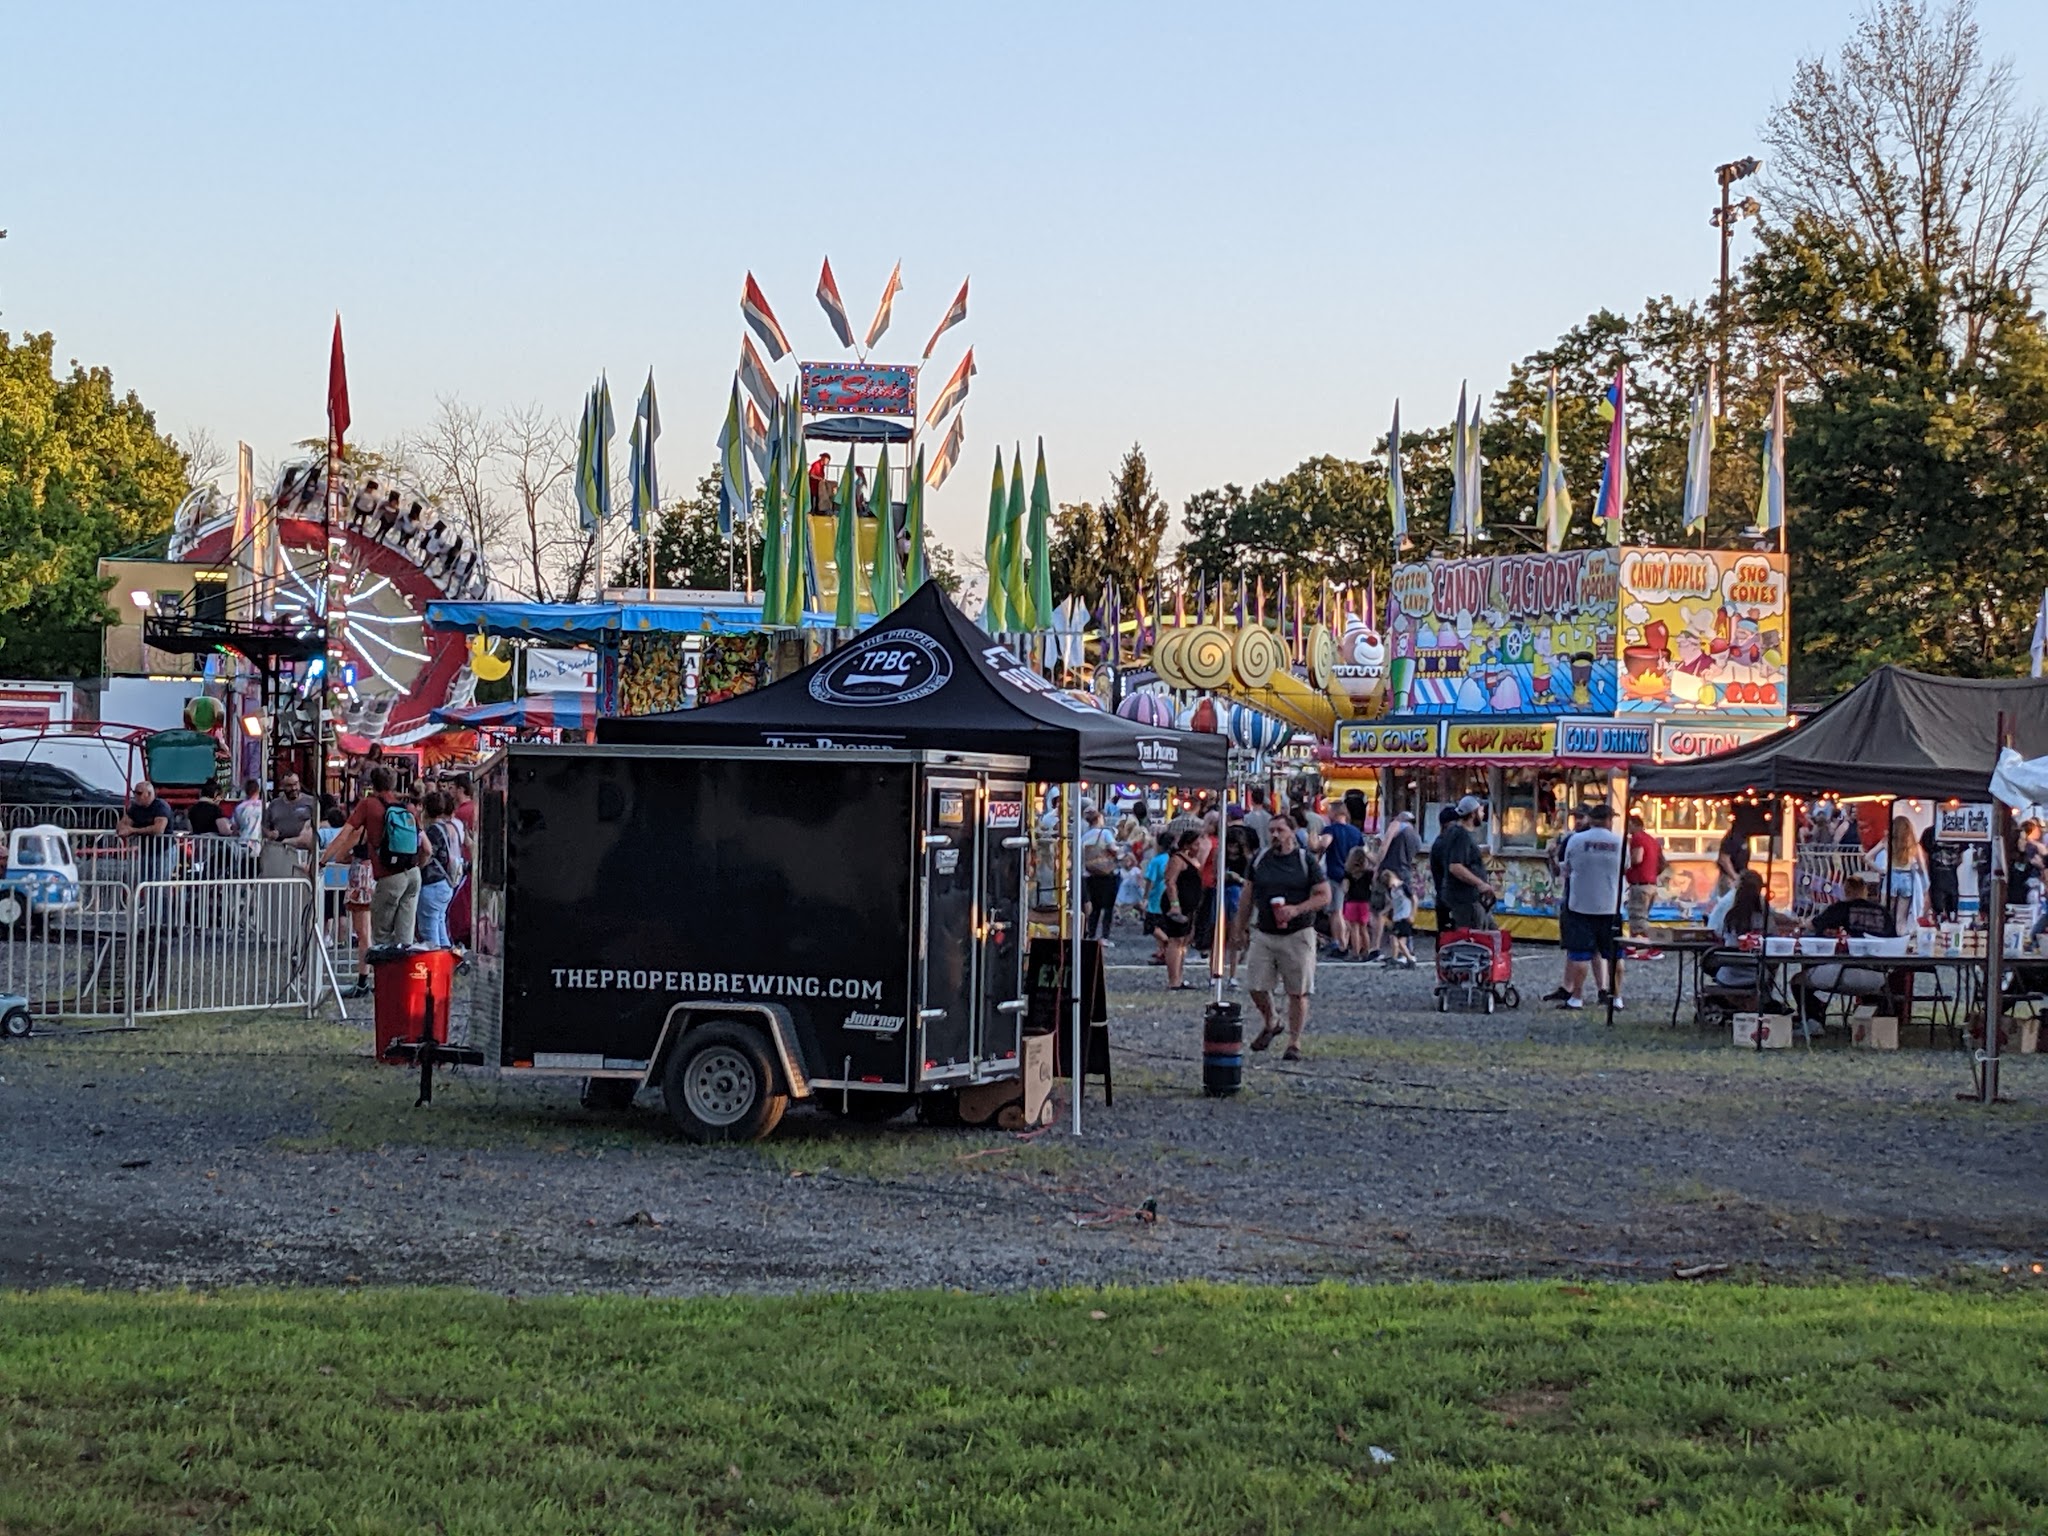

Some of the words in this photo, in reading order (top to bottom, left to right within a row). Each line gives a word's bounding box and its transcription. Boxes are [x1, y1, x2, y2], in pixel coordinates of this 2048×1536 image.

[1395, 571, 1427, 592] COTTON
[1433, 560, 1494, 619] CANDY
[1499, 553, 1581, 617] FACTORY
[1631, 561, 1665, 589] CANDY
[1668, 562, 1707, 592] APPLES
[1738, 566, 1768, 583] SNO
[1729, 584, 1777, 603] CONES
[529, 669, 551, 682] Air
[557, 653, 596, 675] Brush
[860, 651, 917, 671] TPBC
[492, 732, 551, 745] Ticts
[1348, 729, 1377, 752] SNO
[1380, 728, 1428, 752] CONES
[1458, 727, 1499, 753] CANDY
[1500, 727, 1545, 752] APPLES
[1566, 727, 1597, 751] COLD
[1602, 728, 1649, 753] DRINKS
[1669, 731, 1740, 756] COTTON
[551, 968, 882, 1000] THEPROPERBREWING.COM
[842, 1010, 905, 1030] Journey
